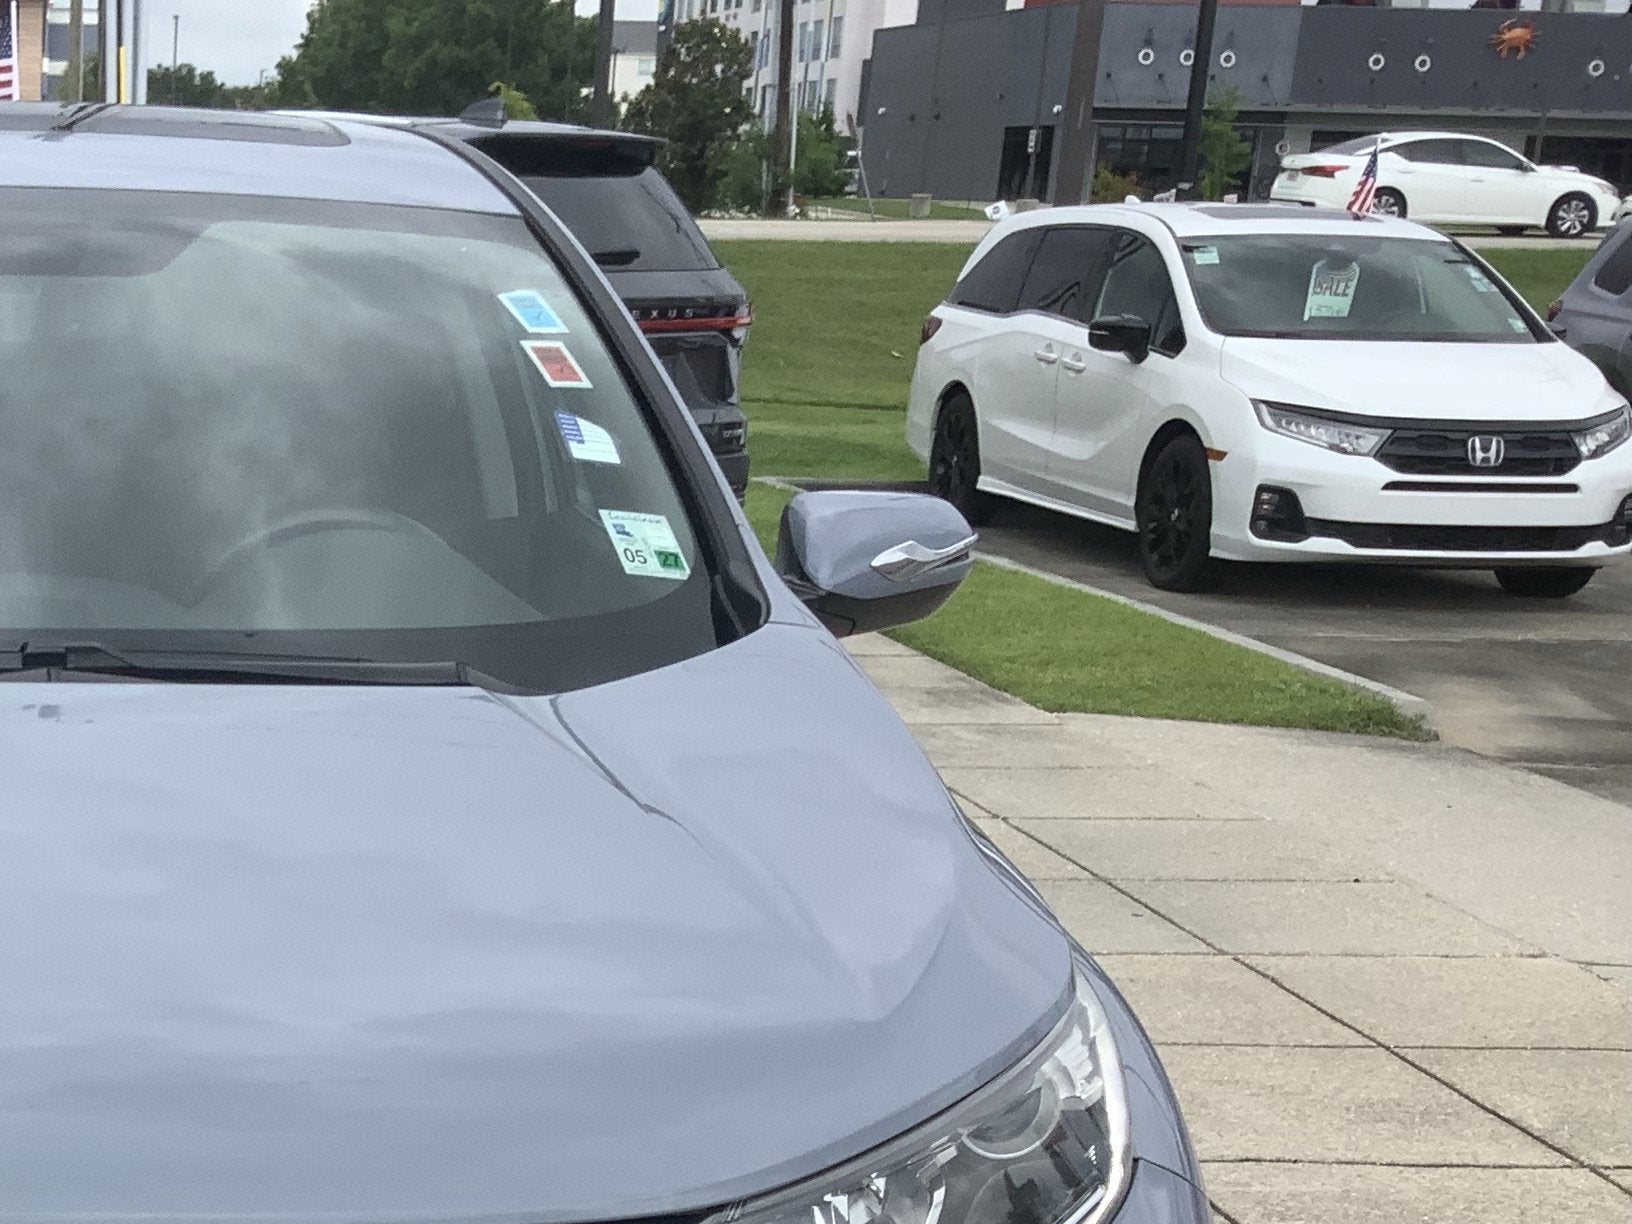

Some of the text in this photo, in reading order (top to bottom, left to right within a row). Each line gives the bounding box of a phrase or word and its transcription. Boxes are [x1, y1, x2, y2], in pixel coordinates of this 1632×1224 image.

[1312, 277, 1354, 297] SALE
[632, 309, 694, 318] EXUS
[623, 547, 648, 565] 05
[657, 551, 680, 568] 27
